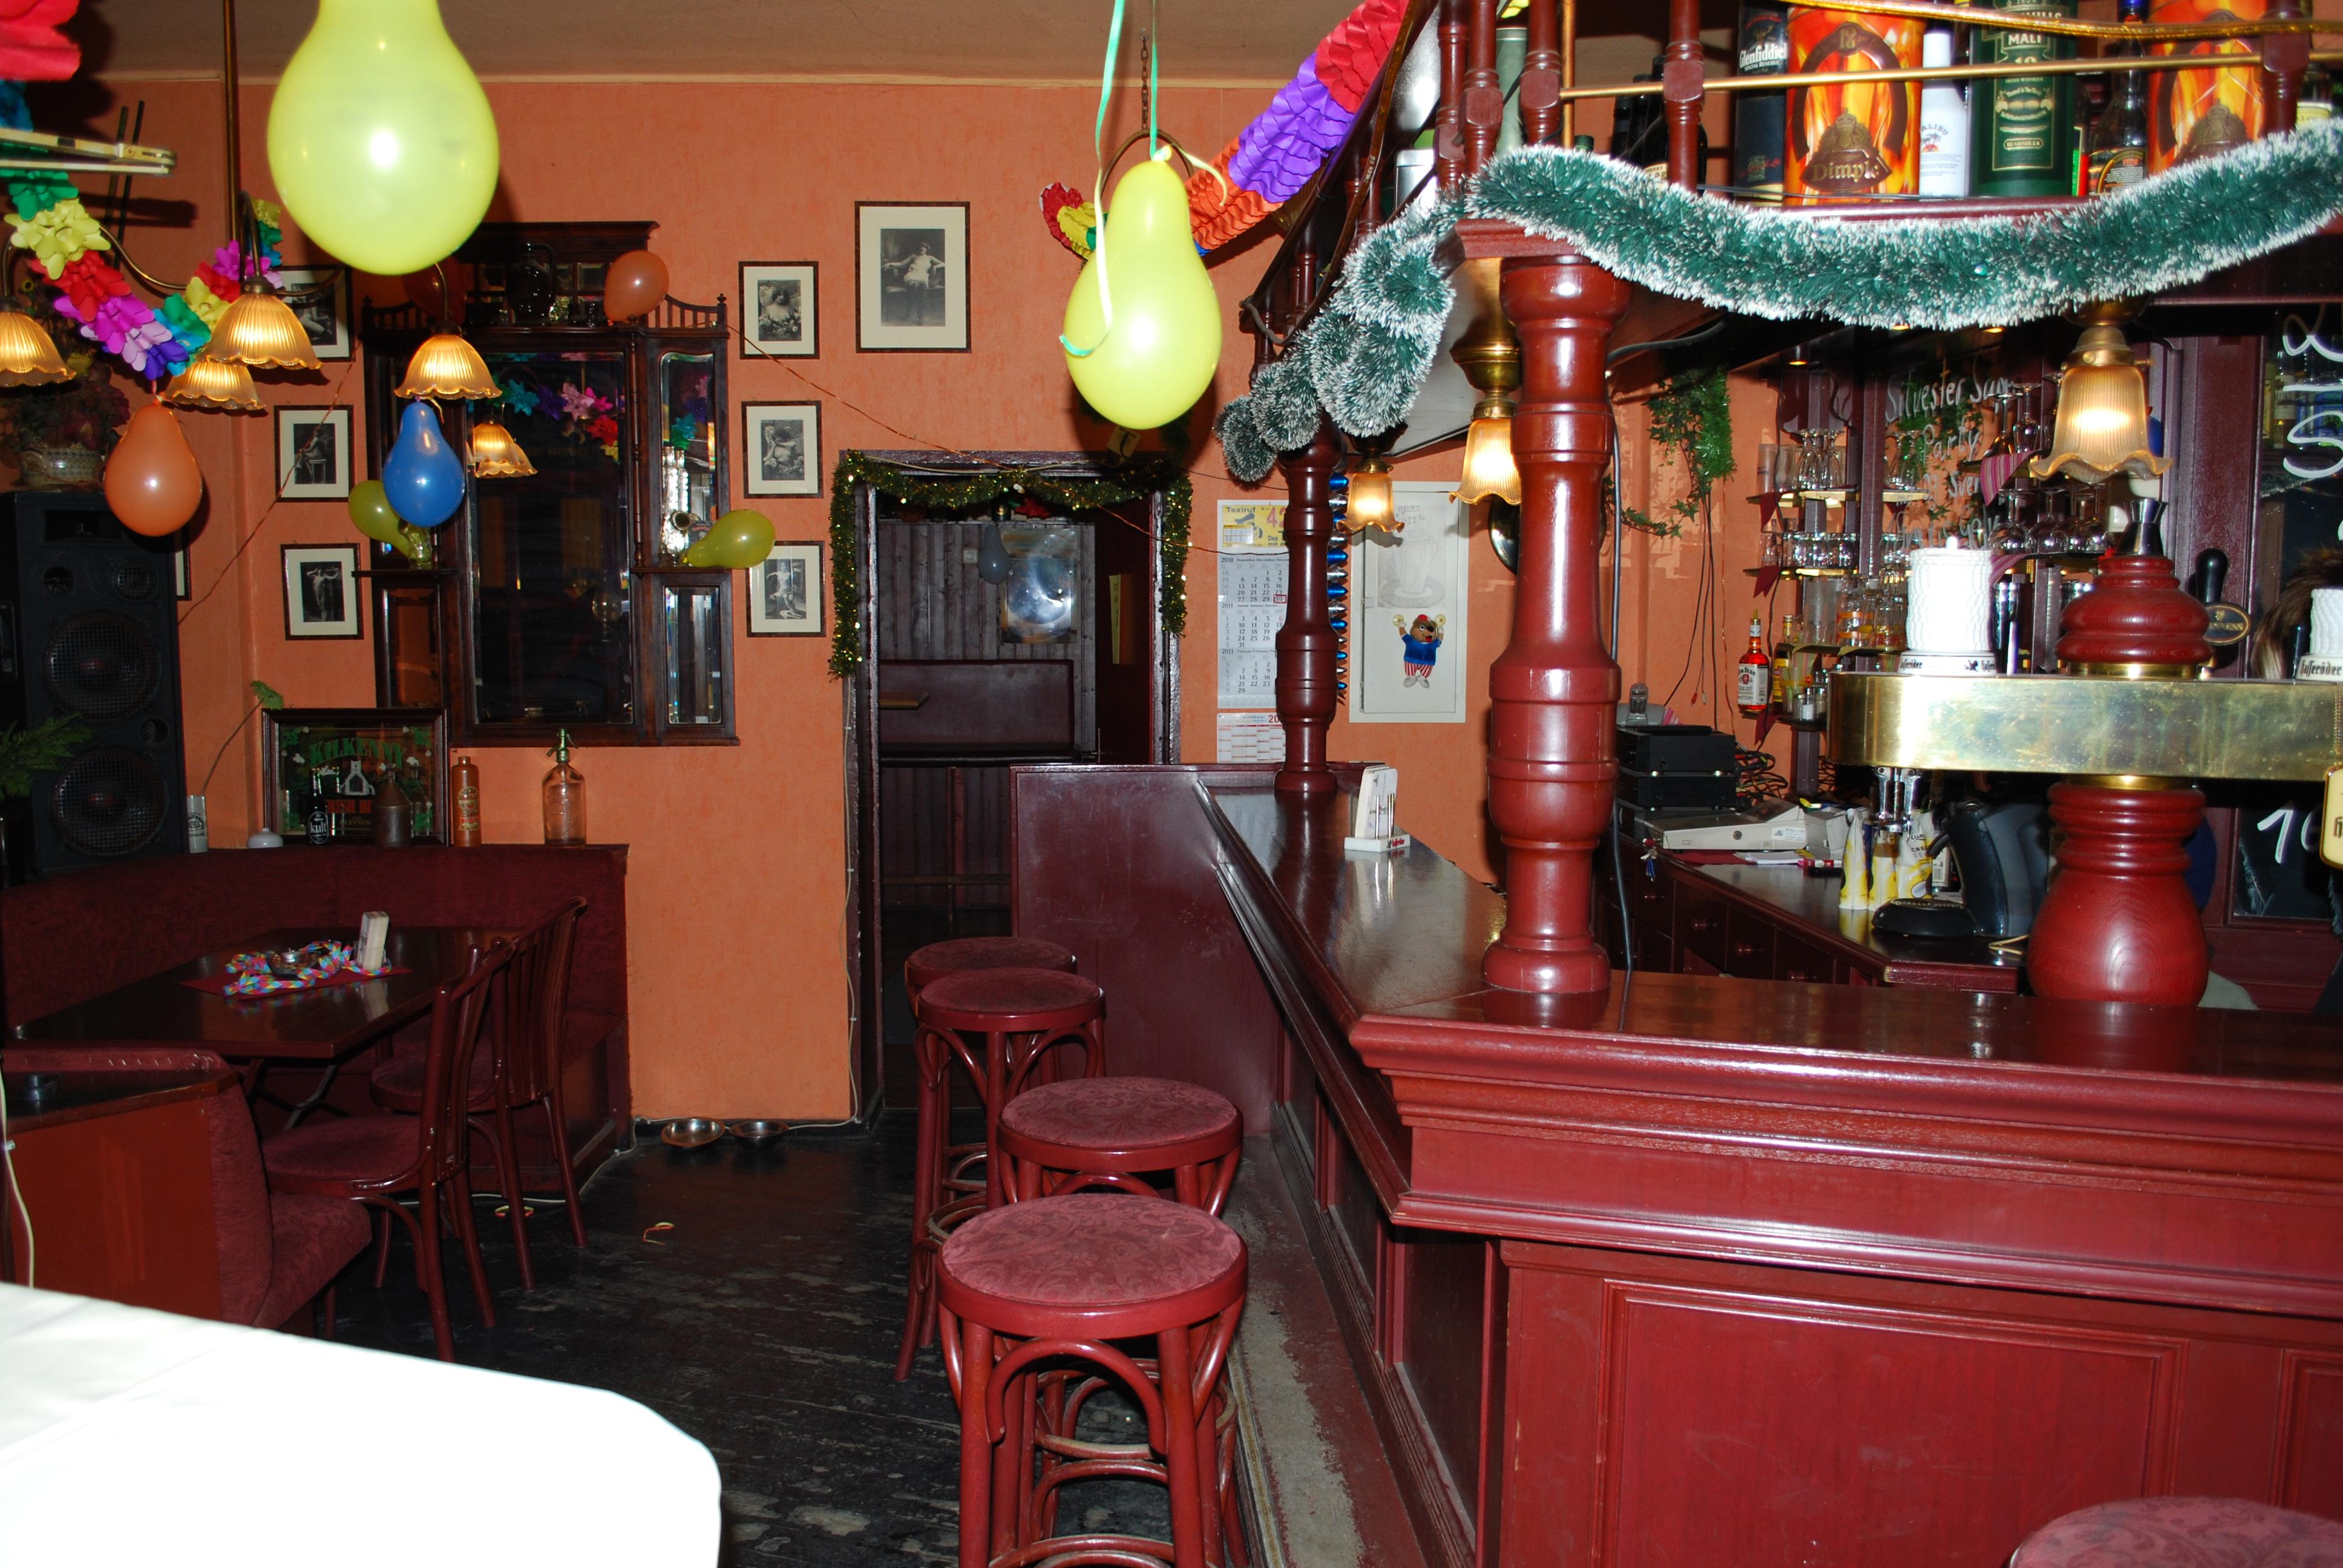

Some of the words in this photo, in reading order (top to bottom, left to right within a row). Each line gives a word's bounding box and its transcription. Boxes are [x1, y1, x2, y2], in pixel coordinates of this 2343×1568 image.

[1921, 123, 1948, 136] ALIBU
[1884, 358, 1967, 423] Silvester
[1922, 423, 1980, 466] Party
[1268, 714, 1279, 723] 20
[309, 737, 407, 769] KILKENNY
